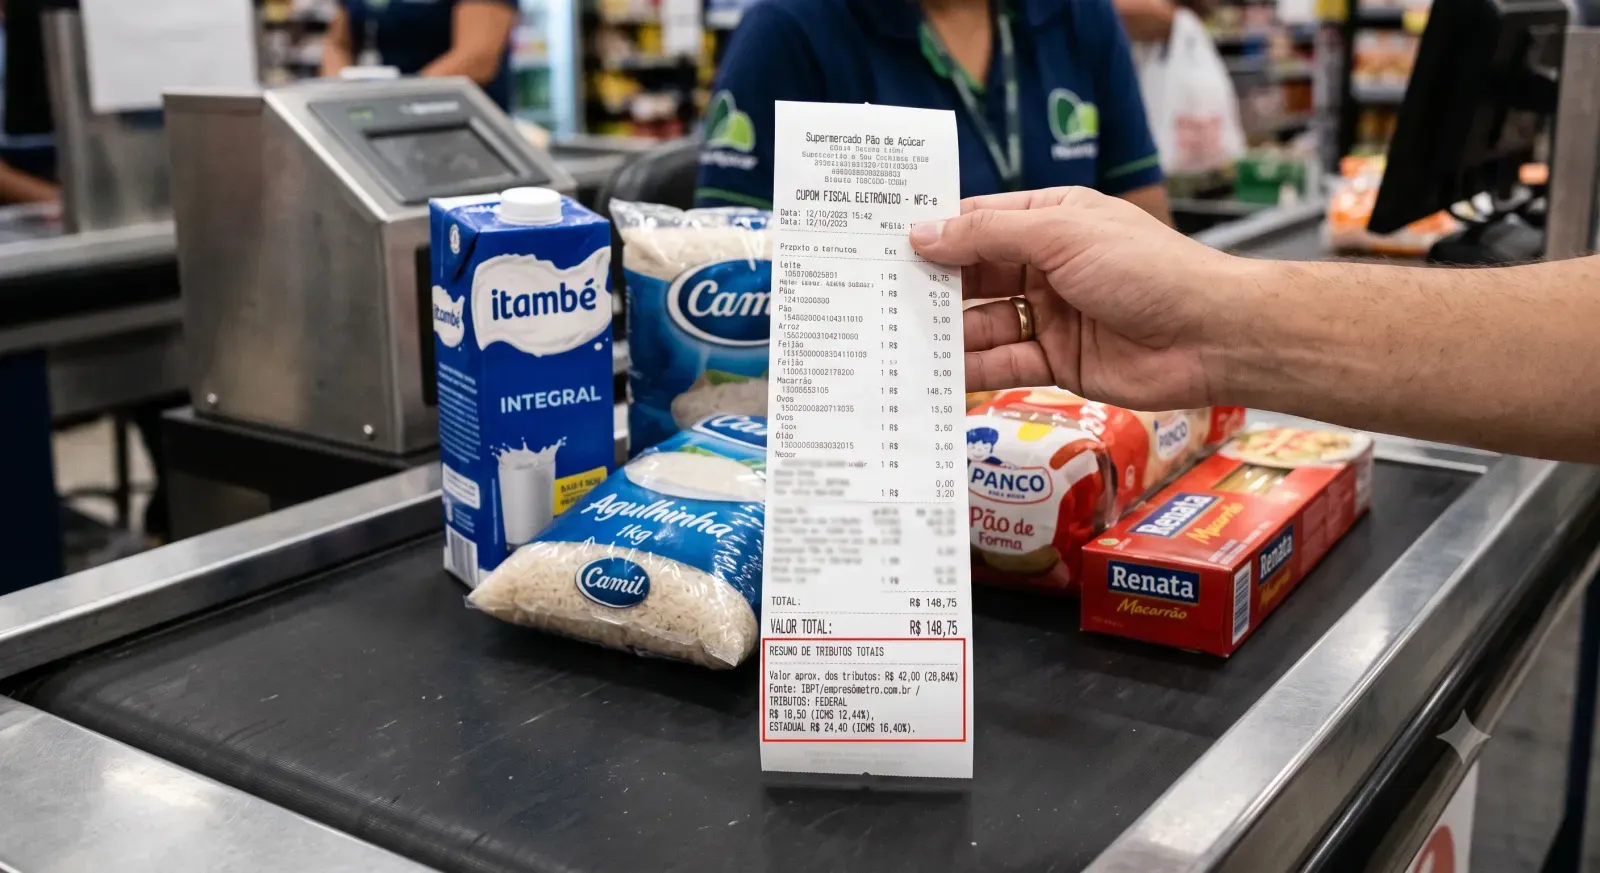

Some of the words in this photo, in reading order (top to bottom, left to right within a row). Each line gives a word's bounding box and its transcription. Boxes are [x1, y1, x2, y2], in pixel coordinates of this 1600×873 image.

[806, 132, 861, 144] Supermercado
[866, 135, 880, 145] Pão
[884, 136, 893, 145] de
[898, 136, 925, 147] Açúcar
[796, 189, 819, 201] CUPOM
[824, 190, 851, 202] FISCAL
[856, 191, 901, 204] ELETRÔNICO
[914, 194, 937, 205] NFC-e
[806, 210, 847, 218] 12/10/2023
[781, 217, 800, 225] Data:
[806, 219, 847, 227] 12/10/2023
[929, 274, 949, 282] 18,75
[491, 278, 596, 320] itambé
[688, 280, 771, 317] Cam
[500, 386, 602, 414] INTEGRAL
[776, 413, 793, 421] Ovos
[935, 424, 952, 432] 3,60
[936, 443, 953, 451] 3,60
[936, 461, 953, 469] 3,10
[936, 480, 954, 488] 0,00
[971, 468, 1044, 492] PANCO
[890, 489, 898, 497] R$
[936, 490, 954, 498] 3,20
[580, 493, 734, 538] Agulhinha
[970, 506, 1010, 532] Pão
[1014, 518, 1035, 536] de
[1136, 495, 1213, 536] Renata
[616, 524, 653, 546] 1kg
[978, 532, 1023, 550] Forma
[586, 567, 646, 596] Camil
[1112, 565, 1194, 599] Renata
[772, 596, 800, 606] TOTAL:
[910, 598, 920, 607] R$
[926, 598, 957, 608] 148,75
[1116, 597, 1187, 619] Macarrão
[770, 618, 797, 634] VALOR
[802, 618, 832, 634] TOTAL:
[910, 620, 922, 636] R$
[926, 620, 958, 638] 148,75
[802, 646, 811, 656] DE
[816, 646, 852, 656] TRIBUTOS
[857, 647, 884, 656] TOTAIS
[770, 670, 791, 680] Valor
[825, 671, 838, 680] dos
[843, 671, 880, 680] tributos:
[885, 671, 894, 682] R$
[899, 671, 920, 682] 42,00
[925, 671, 958, 682] (28,84%)
[770, 684, 796, 693] Fonte:
[916, 685, 920, 696] /
[770, 696, 809, 706] TRIBUTOS:
[816, 697, 847, 706] FEDERAL
[770, 709, 778, 719] R$
[784, 709, 806, 720] 18,50
[811, 709, 833, 720] (ICMS
[839, 710, 874, 720] 12,44%),
[770, 722, 806, 731] ESTADUAL
[811, 722, 820, 733] R$
[825, 723, 847, 733] 24,40
[852, 723, 875, 733] (ICMS
[880, 723, 915, 733] 16,40%).
